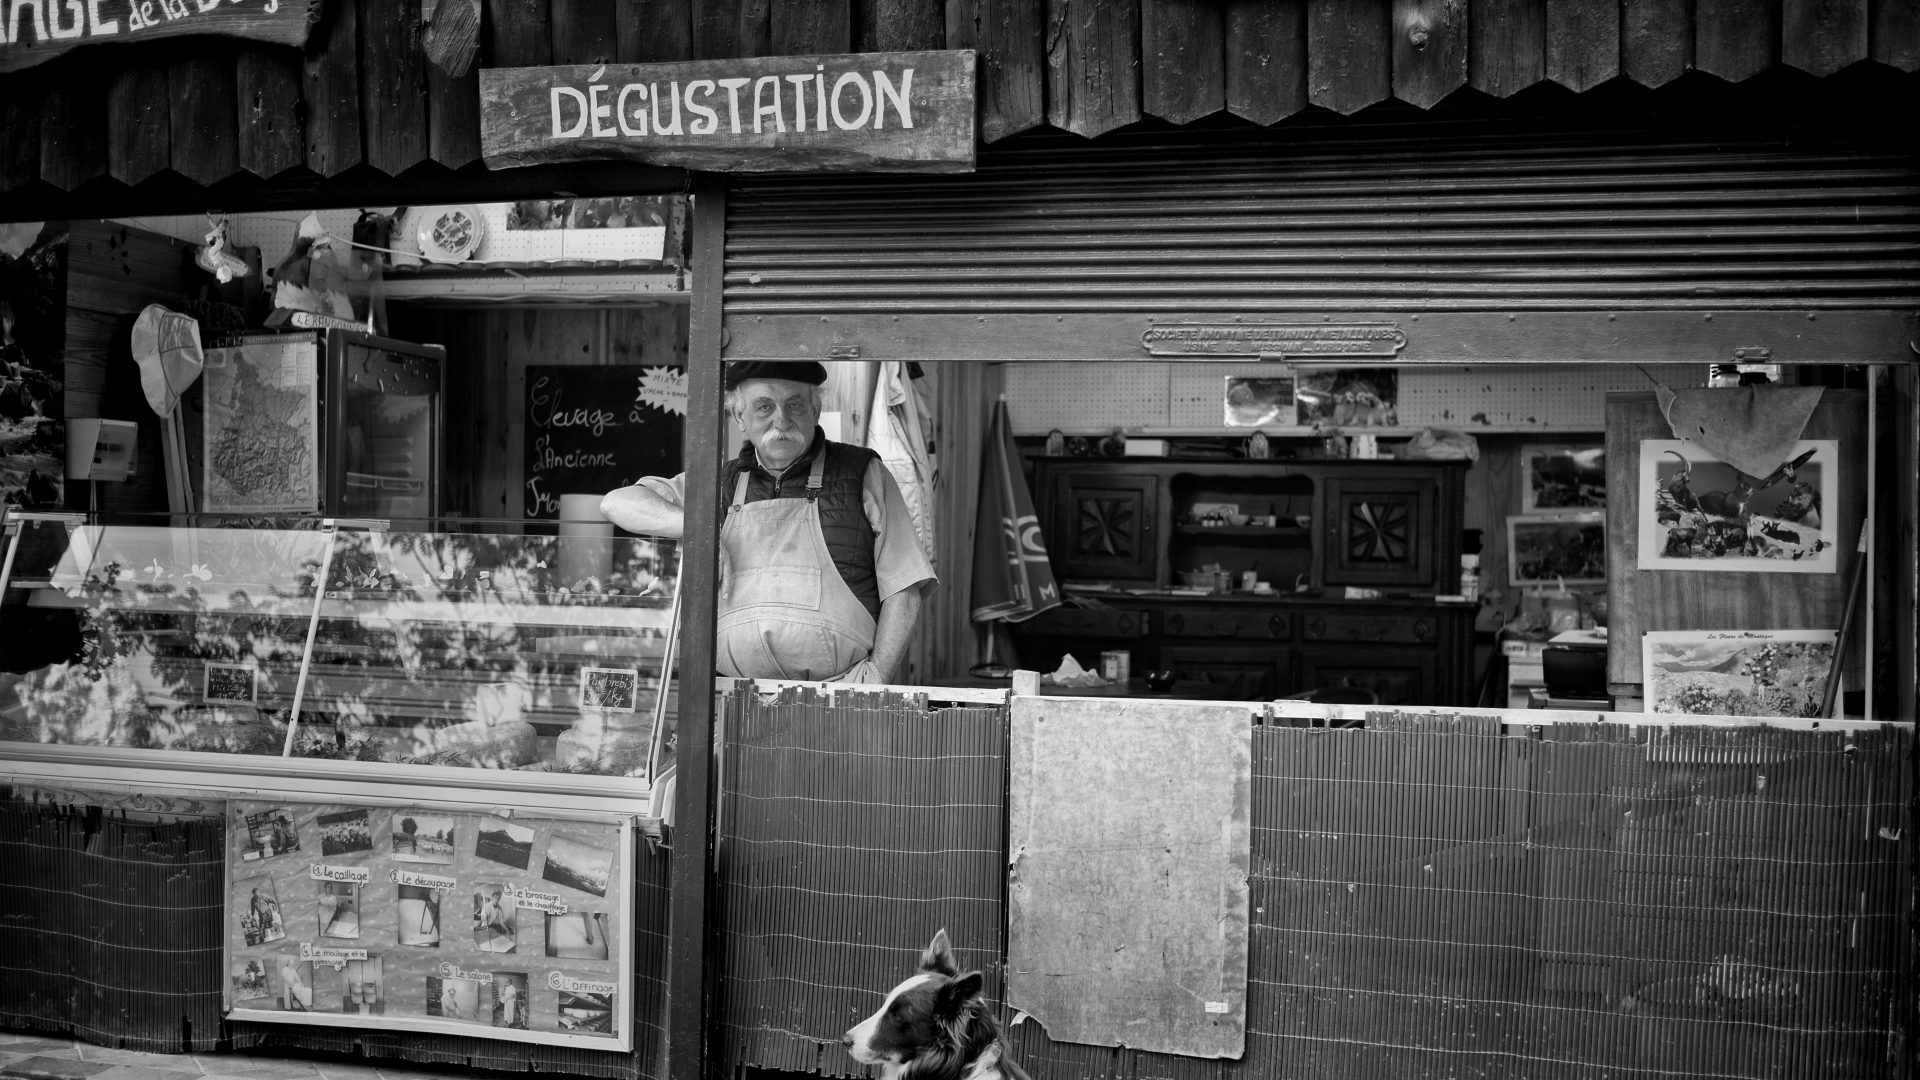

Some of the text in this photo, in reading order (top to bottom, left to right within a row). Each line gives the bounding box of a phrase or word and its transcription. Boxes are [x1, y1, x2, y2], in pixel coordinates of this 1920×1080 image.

[130, 0, 160, 31] de
[324, 866, 333, 878] Le
[334, 868, 368, 888] caillage
[402, 872, 412, 885] Le
[414, 875, 455, 891] découpage
[311, 948, 321, 957] Le
[456, 967, 466, 979] Le
